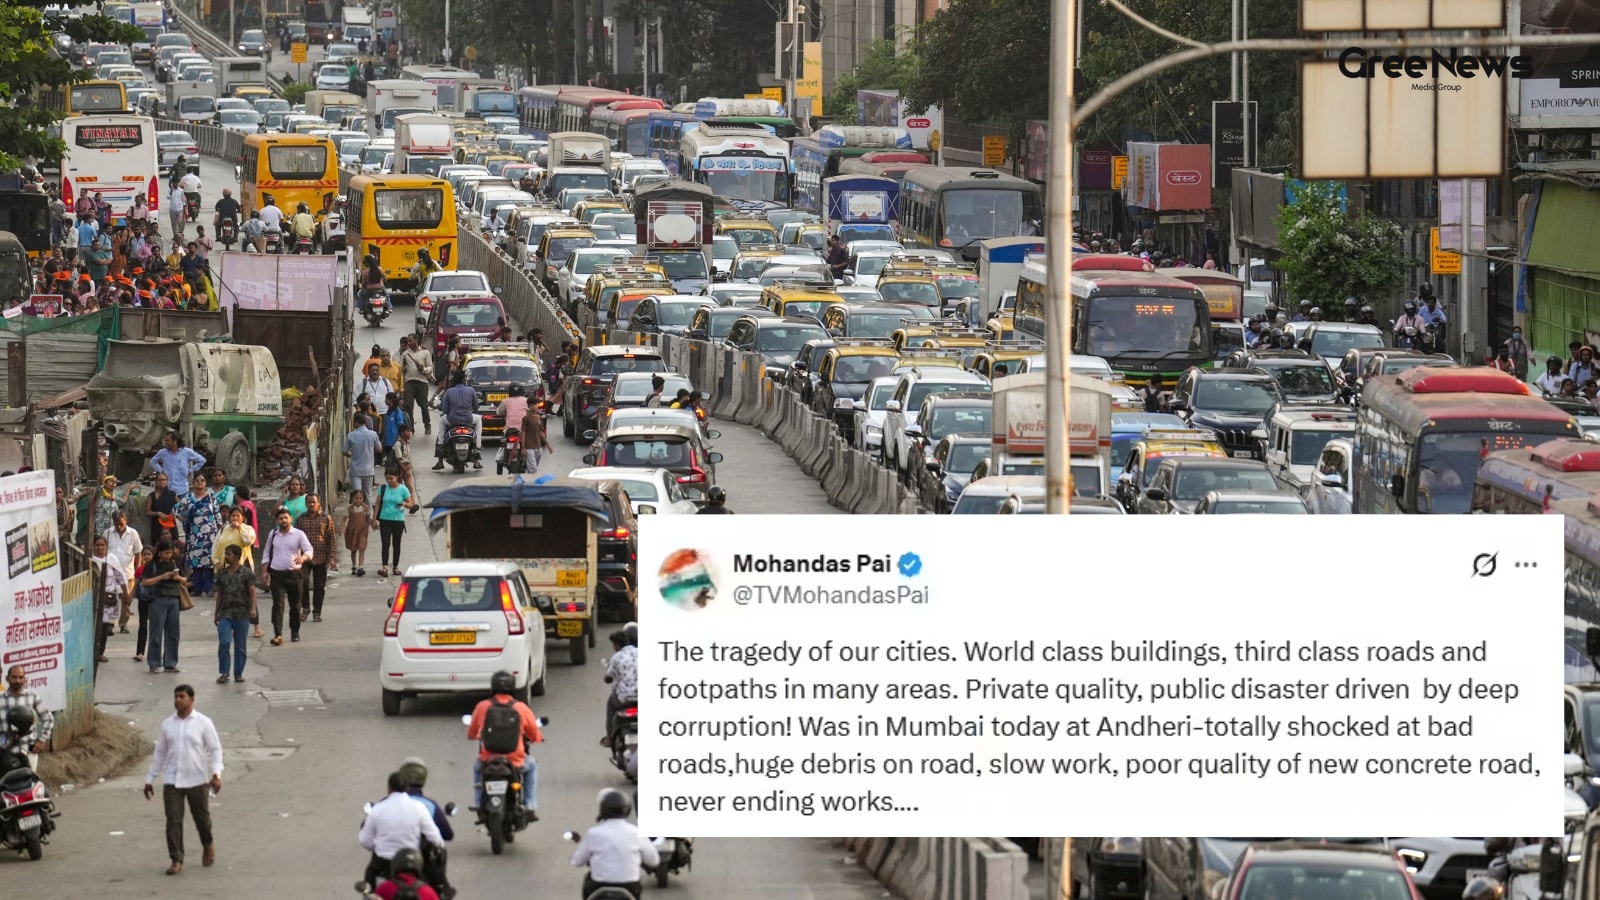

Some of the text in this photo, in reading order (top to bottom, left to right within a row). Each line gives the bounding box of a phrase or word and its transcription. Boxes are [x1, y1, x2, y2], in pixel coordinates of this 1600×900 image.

[1531, 98, 1600, 108] EMPORIO AR
[81, 128, 138, 139] VINAYAK
[1085, 152, 1109, 162] बेस्ट
[1171, 172, 1197, 182] बेस्ट
[257, 403, 279, 411] SCHWING
[1487, 418, 1513, 430] बेस्ट
[14, 581, 54, 611] जन-आक्रोश
[6, 612, 61, 644] महिला सम्मेलन
